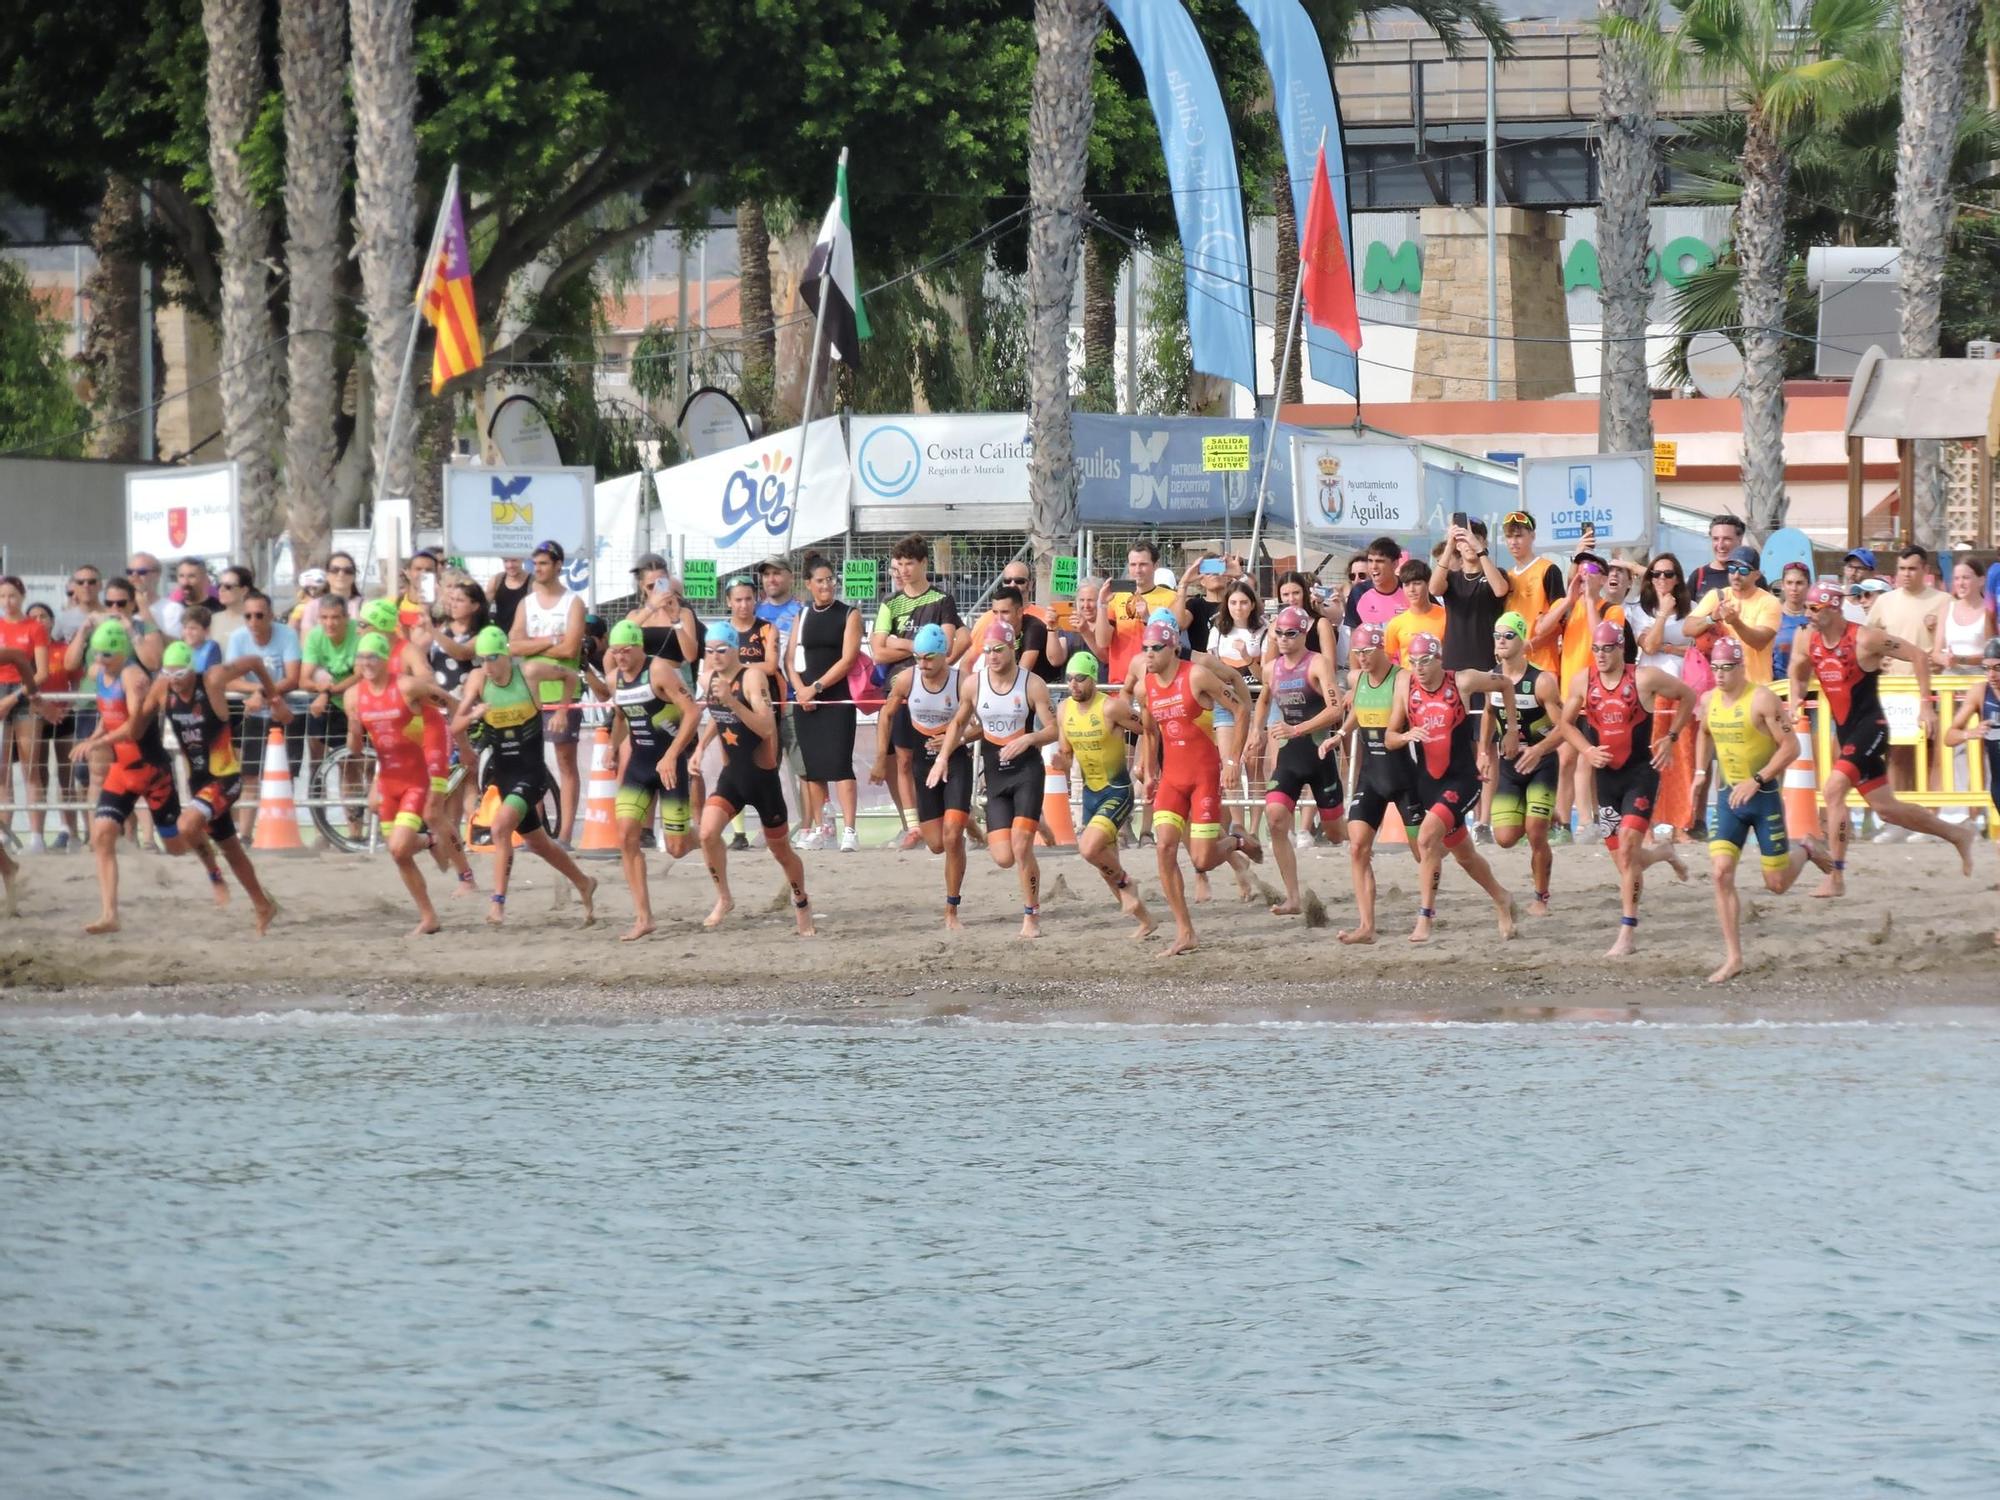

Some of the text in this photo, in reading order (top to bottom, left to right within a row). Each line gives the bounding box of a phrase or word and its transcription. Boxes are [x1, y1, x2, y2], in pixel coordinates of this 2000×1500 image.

[1848, 267, 1890, 275] JUNKERS
[926, 442, 1034, 460] Costa Cálida
[960, 464, 972, 475] de
[973, 464, 1005, 475] Murcia
[1170, 480, 1210, 493] DEPORTIVO
[1347, 480, 1399, 492] Ayuntamiento
[1367, 492, 1377, 502] de
[1169, 498, 1208, 510] MUNICIPAL
[1351, 501, 1400, 526] Águilas
[1551, 506, 1613, 525] LOTERÍAS
[684, 561, 715, 573] SALIDA
[846, 561, 875, 575] SALIDA
[683, 584, 715, 597] SALIDA
[845, 584, 875, 597] SALIDA
[1299, 618, 1307, 628] 9
[1371, 633, 1379, 644] 9
[1428, 641, 1437, 652] 9
[1601, 711, 1623, 724] SALTO
